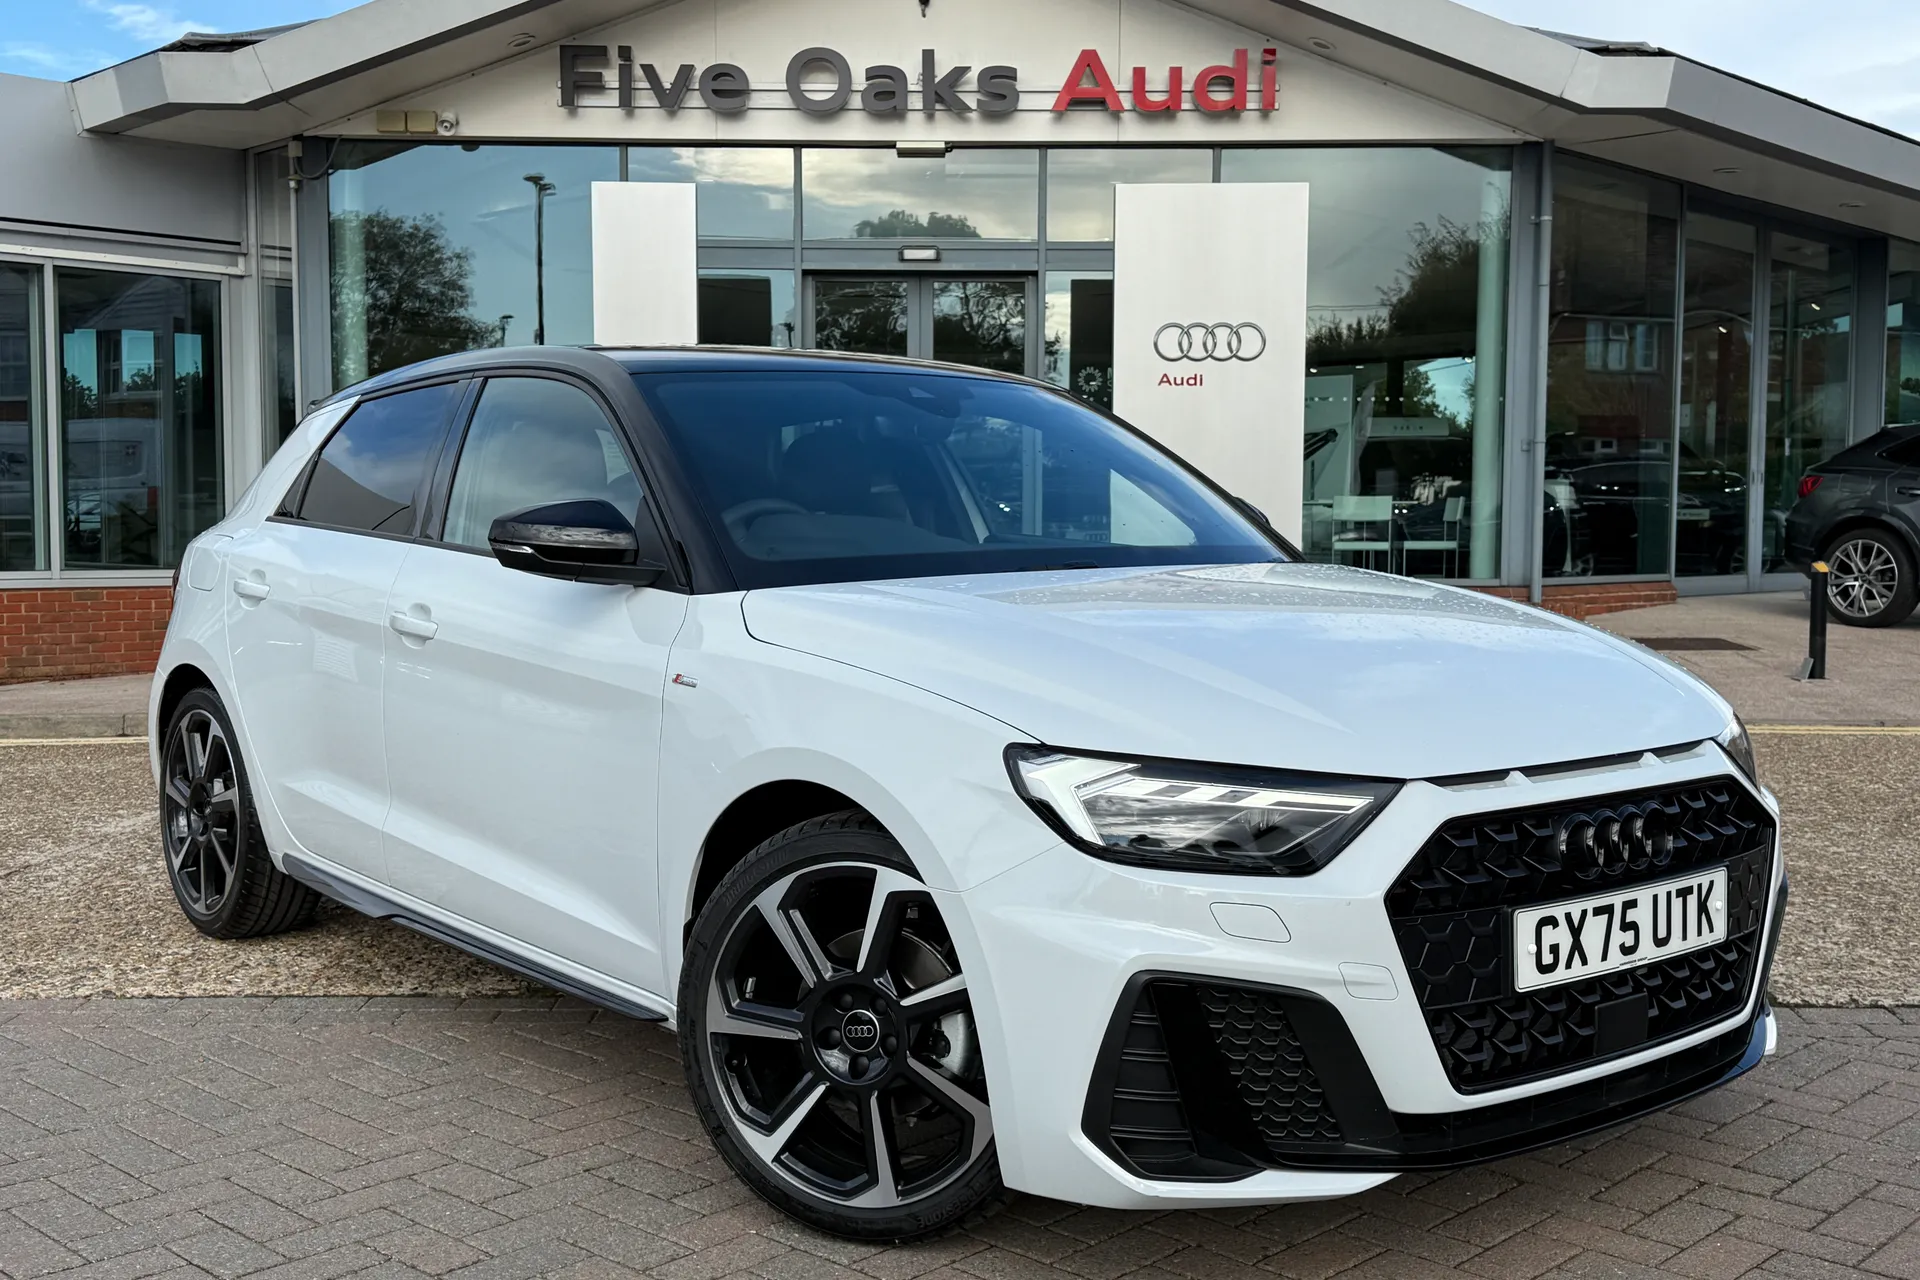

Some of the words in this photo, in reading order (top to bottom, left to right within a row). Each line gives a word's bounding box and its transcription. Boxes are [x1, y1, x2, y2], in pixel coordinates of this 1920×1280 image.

[559, 45, 749, 112] Five
[786, 47, 1019, 114] Oaks
[1051, 48, 1277, 112] Audi
[1157, 373, 1204, 386] Audi
[1535, 898, 1640, 975] GX75
[1652, 879, 1715, 948] UTK
